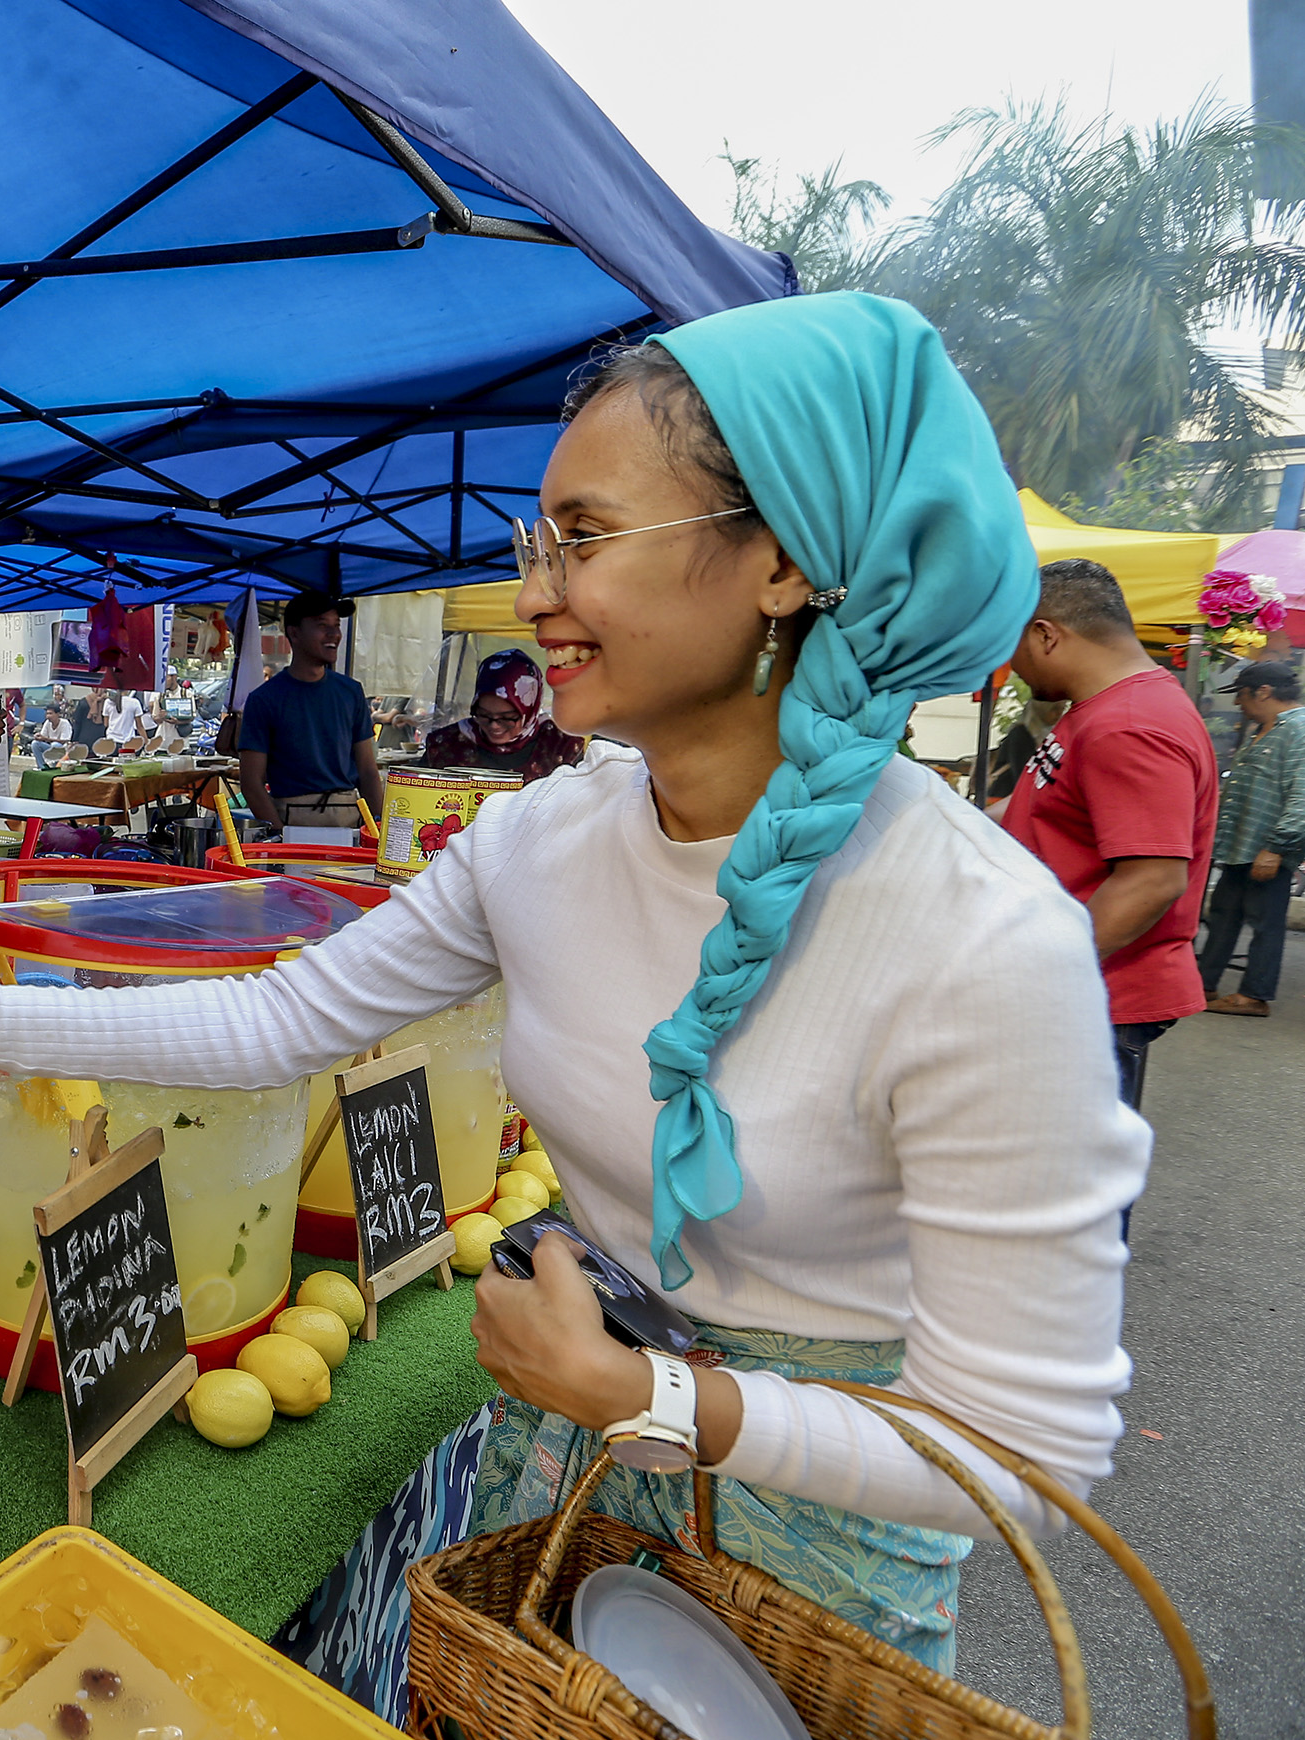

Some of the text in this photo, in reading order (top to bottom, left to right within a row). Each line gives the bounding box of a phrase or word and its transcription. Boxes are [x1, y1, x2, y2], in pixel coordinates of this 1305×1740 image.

[350, 1081, 420, 1159] LEMON
[50, 1191, 146, 1298] LEMON
[365, 1182, 441, 1257] RM3
